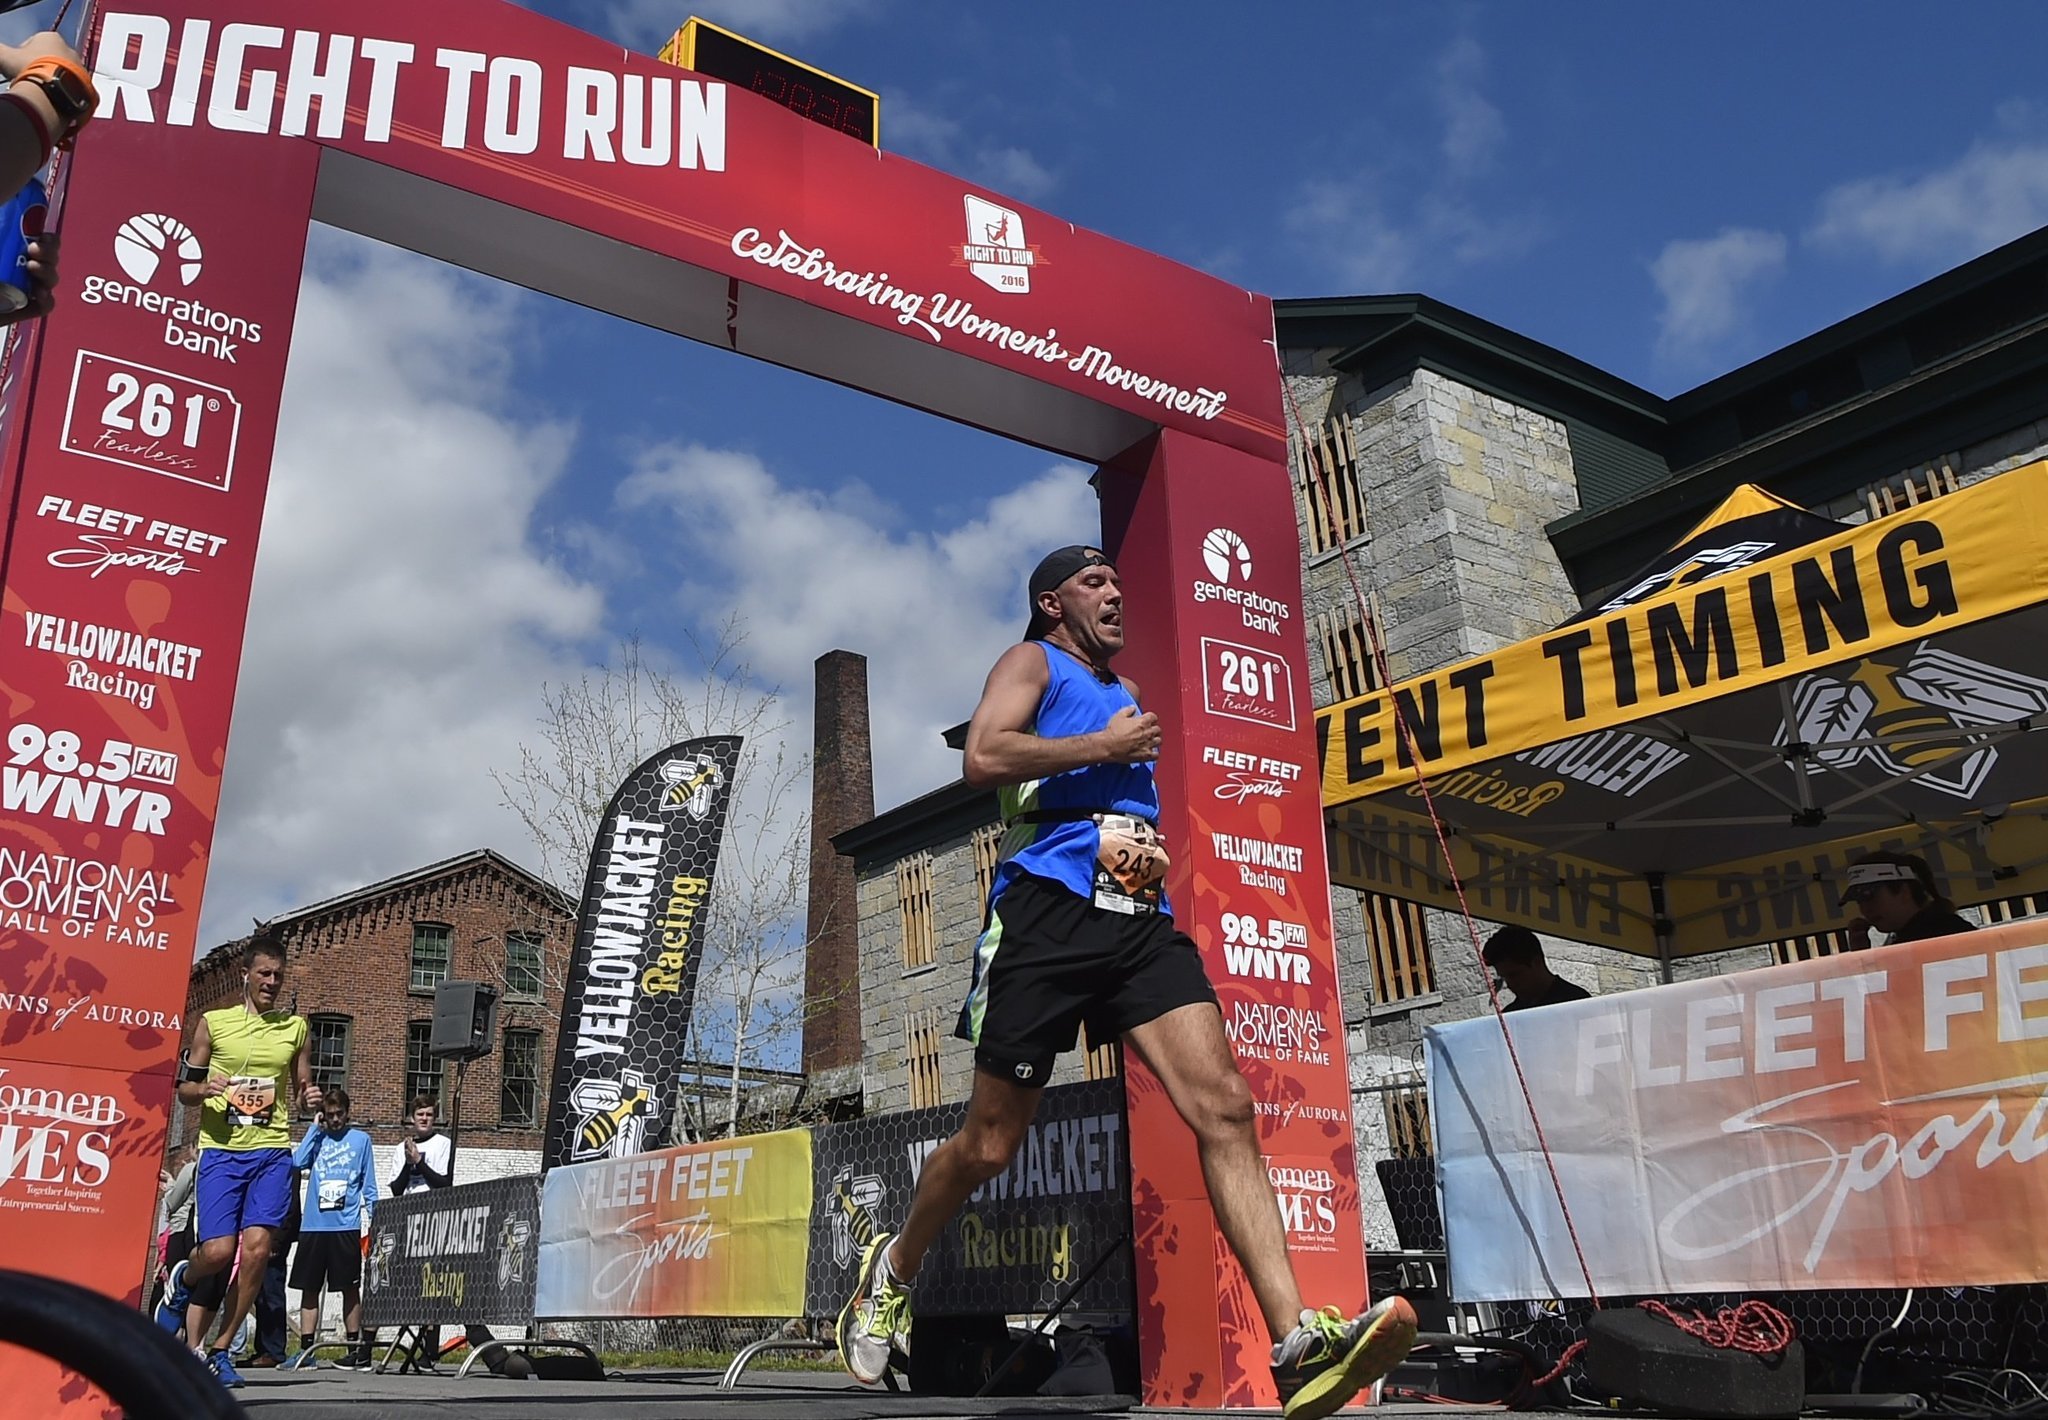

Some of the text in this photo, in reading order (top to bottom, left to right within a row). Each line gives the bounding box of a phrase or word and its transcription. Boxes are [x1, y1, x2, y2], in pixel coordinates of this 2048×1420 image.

[92, 12, 727, 172] RIGHT TO RUN
[963, 245, 1034, 265] RIGHT TO RUN
[1001, 274, 1025, 287] 2016
[80, 275, 262, 343] generations
[731, 227, 1227, 420] Celebrating Women's Movement
[164, 319, 237, 363] bank
[94, 428, 198, 470] Fearless
[37, 494, 228, 558] FLEET FEET
[47, 535, 201, 578] Sports
[1193, 580, 1290, 619] generations
[1542, 519, 1960, 721] TIMING
[1242, 607, 1281, 636] bank
[25, 611, 202, 682] YELLOWJACKET
[64, 659, 157, 710] Racing
[1222, 694, 1278, 718] Fearless
[7, 723, 172, 783] 98.5 FM
[1203, 746, 1302, 781] FLEET FEET
[2, 766, 172, 836] WNYR
[1214, 772, 1292, 805] Sports
[1113, 848, 1155, 880] 243
[1211, 832, 1303, 873] YELLOWJACKET
[0, 847, 175, 903] NATIONAL
[1239, 864, 1286, 896] Racing
[62, 918, 96, 939] OF
[106, 925, 169, 950] FAME
[575, 815, 665, 1060] YELLOWJACKET
[642, 874, 708, 996] Racing
[1220, 912, 1305, 949] 98.5 FM
[1223, 943, 1311, 985] WNYR
[52, 995, 91, 1032] of
[84, 1004, 182, 1031] AURORA
[1234, 1000, 1327, 1034] NATIONAL
[1574, 970, 1888, 1097] FLEET
[1238, 1044, 1330, 1066] HALL OF FAME
[237, 1093, 264, 1108] 355
[1283, 1101, 1299, 1127] of
[1298, 1106, 1348, 1121] AURORA
[26, 1184, 102, 1202] Together Inspiring
[582, 1147, 753, 1210] FLEET FEET
[405, 1205, 490, 1259] YELLOWJACKET
[960, 1212, 1070, 1282] Racing
[592, 1206, 731, 1308] Sports
[420, 1262, 466, 1308] Racing
